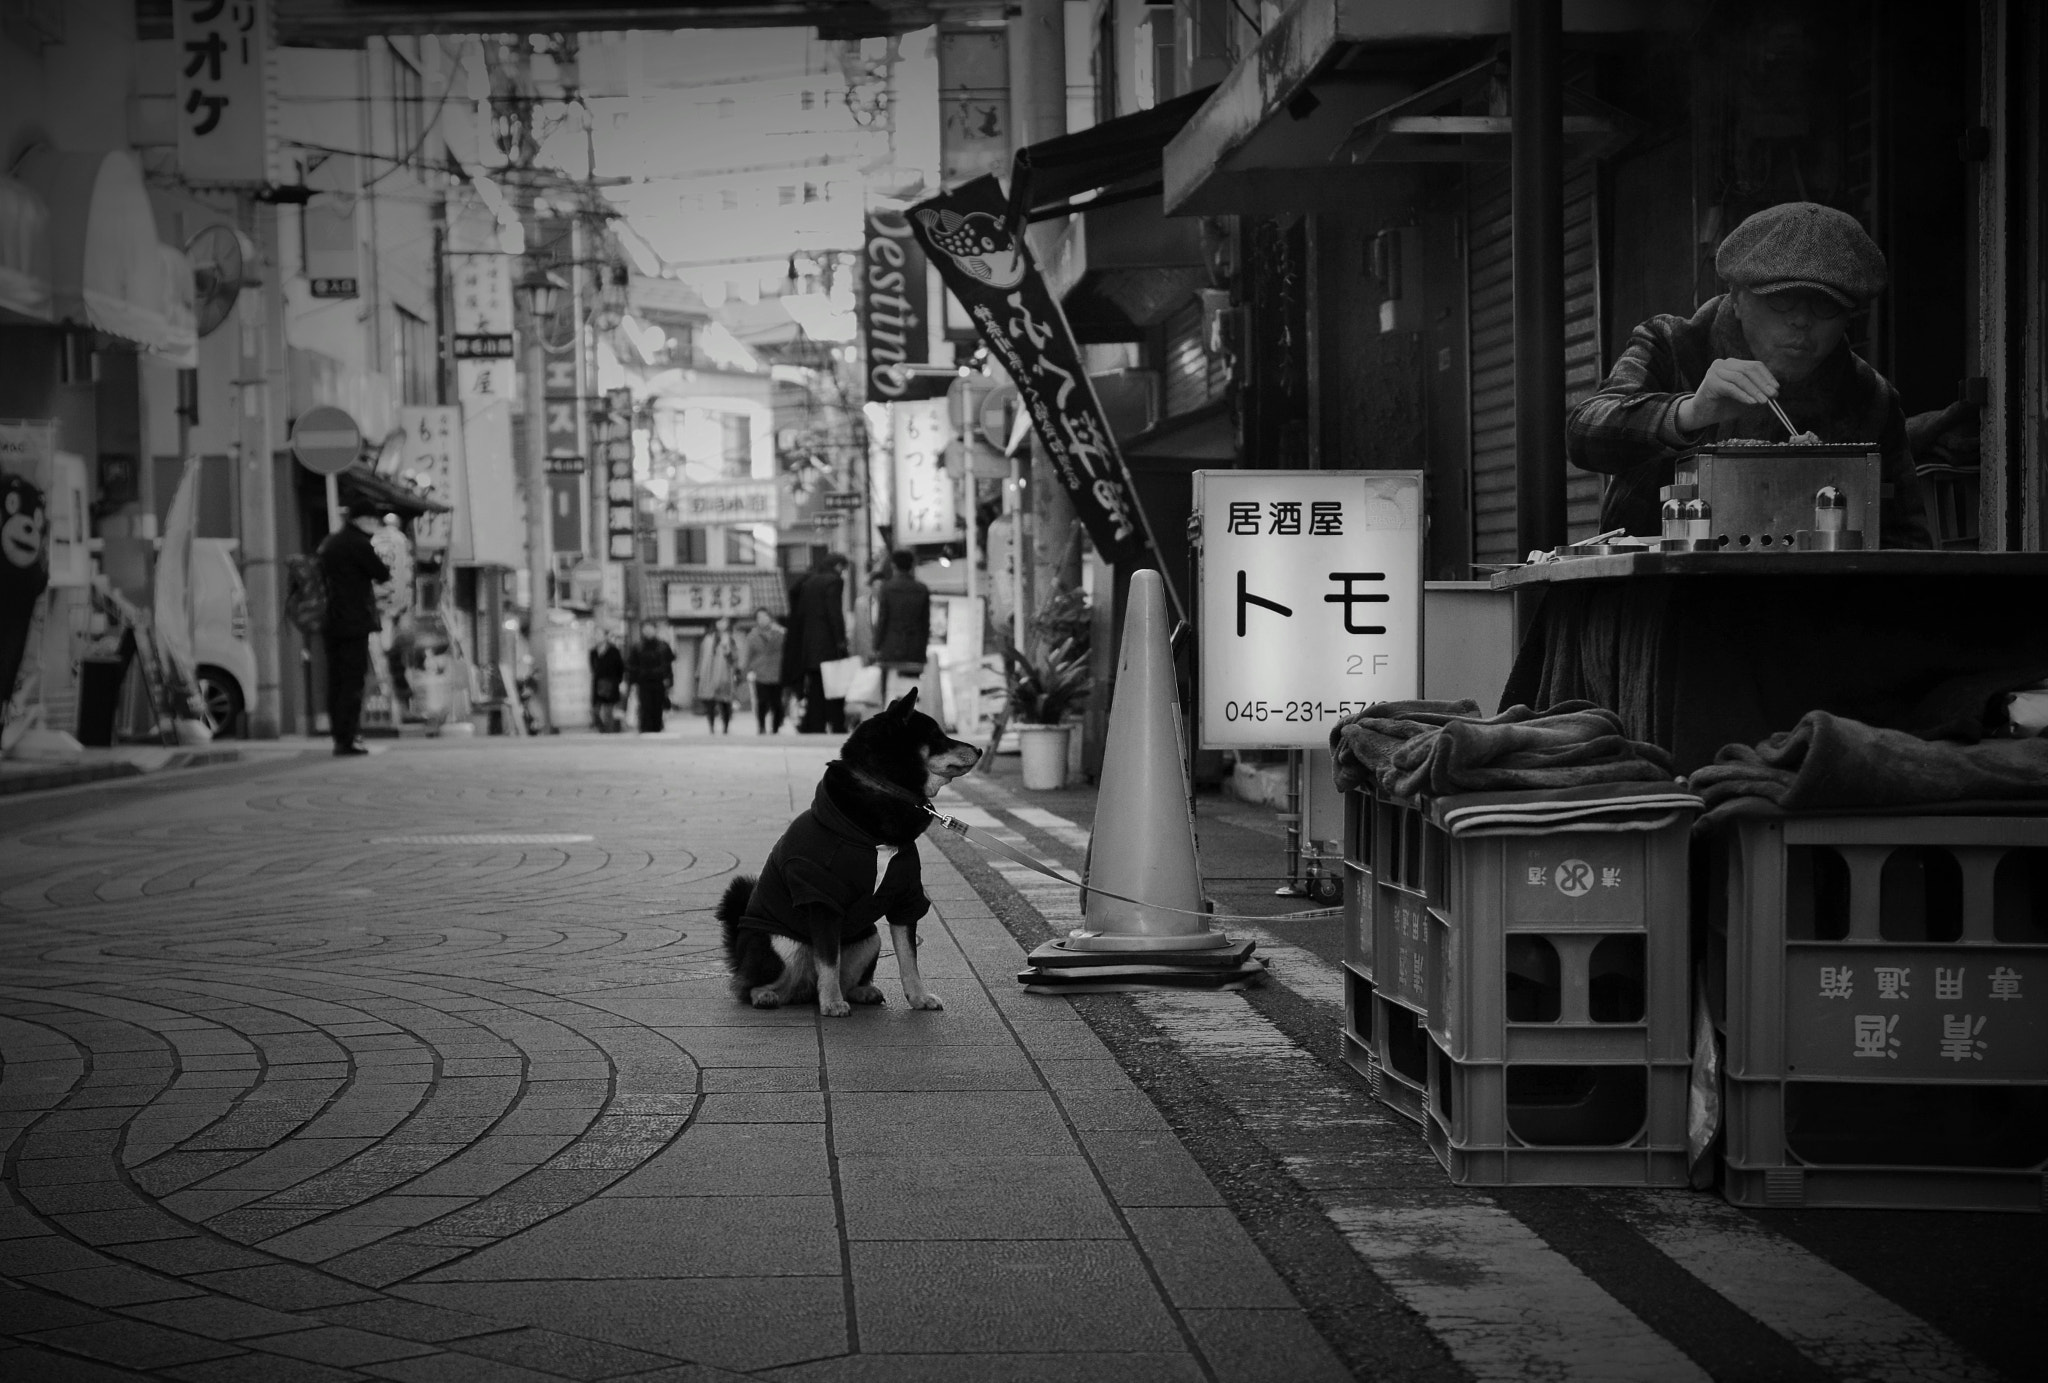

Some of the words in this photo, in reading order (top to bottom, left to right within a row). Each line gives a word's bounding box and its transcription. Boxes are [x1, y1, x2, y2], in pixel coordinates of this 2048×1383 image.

[415, 415, 437, 538] もつげ
[1227, 502, 1344, 536] 居酒屋
[1237, 569, 1390, 638] トモ
[1346, 654, 1389, 675] 2F
[1225, 701, 1376, 722] 045-231-57
[1852, 1013, 1989, 1063] 清酒
